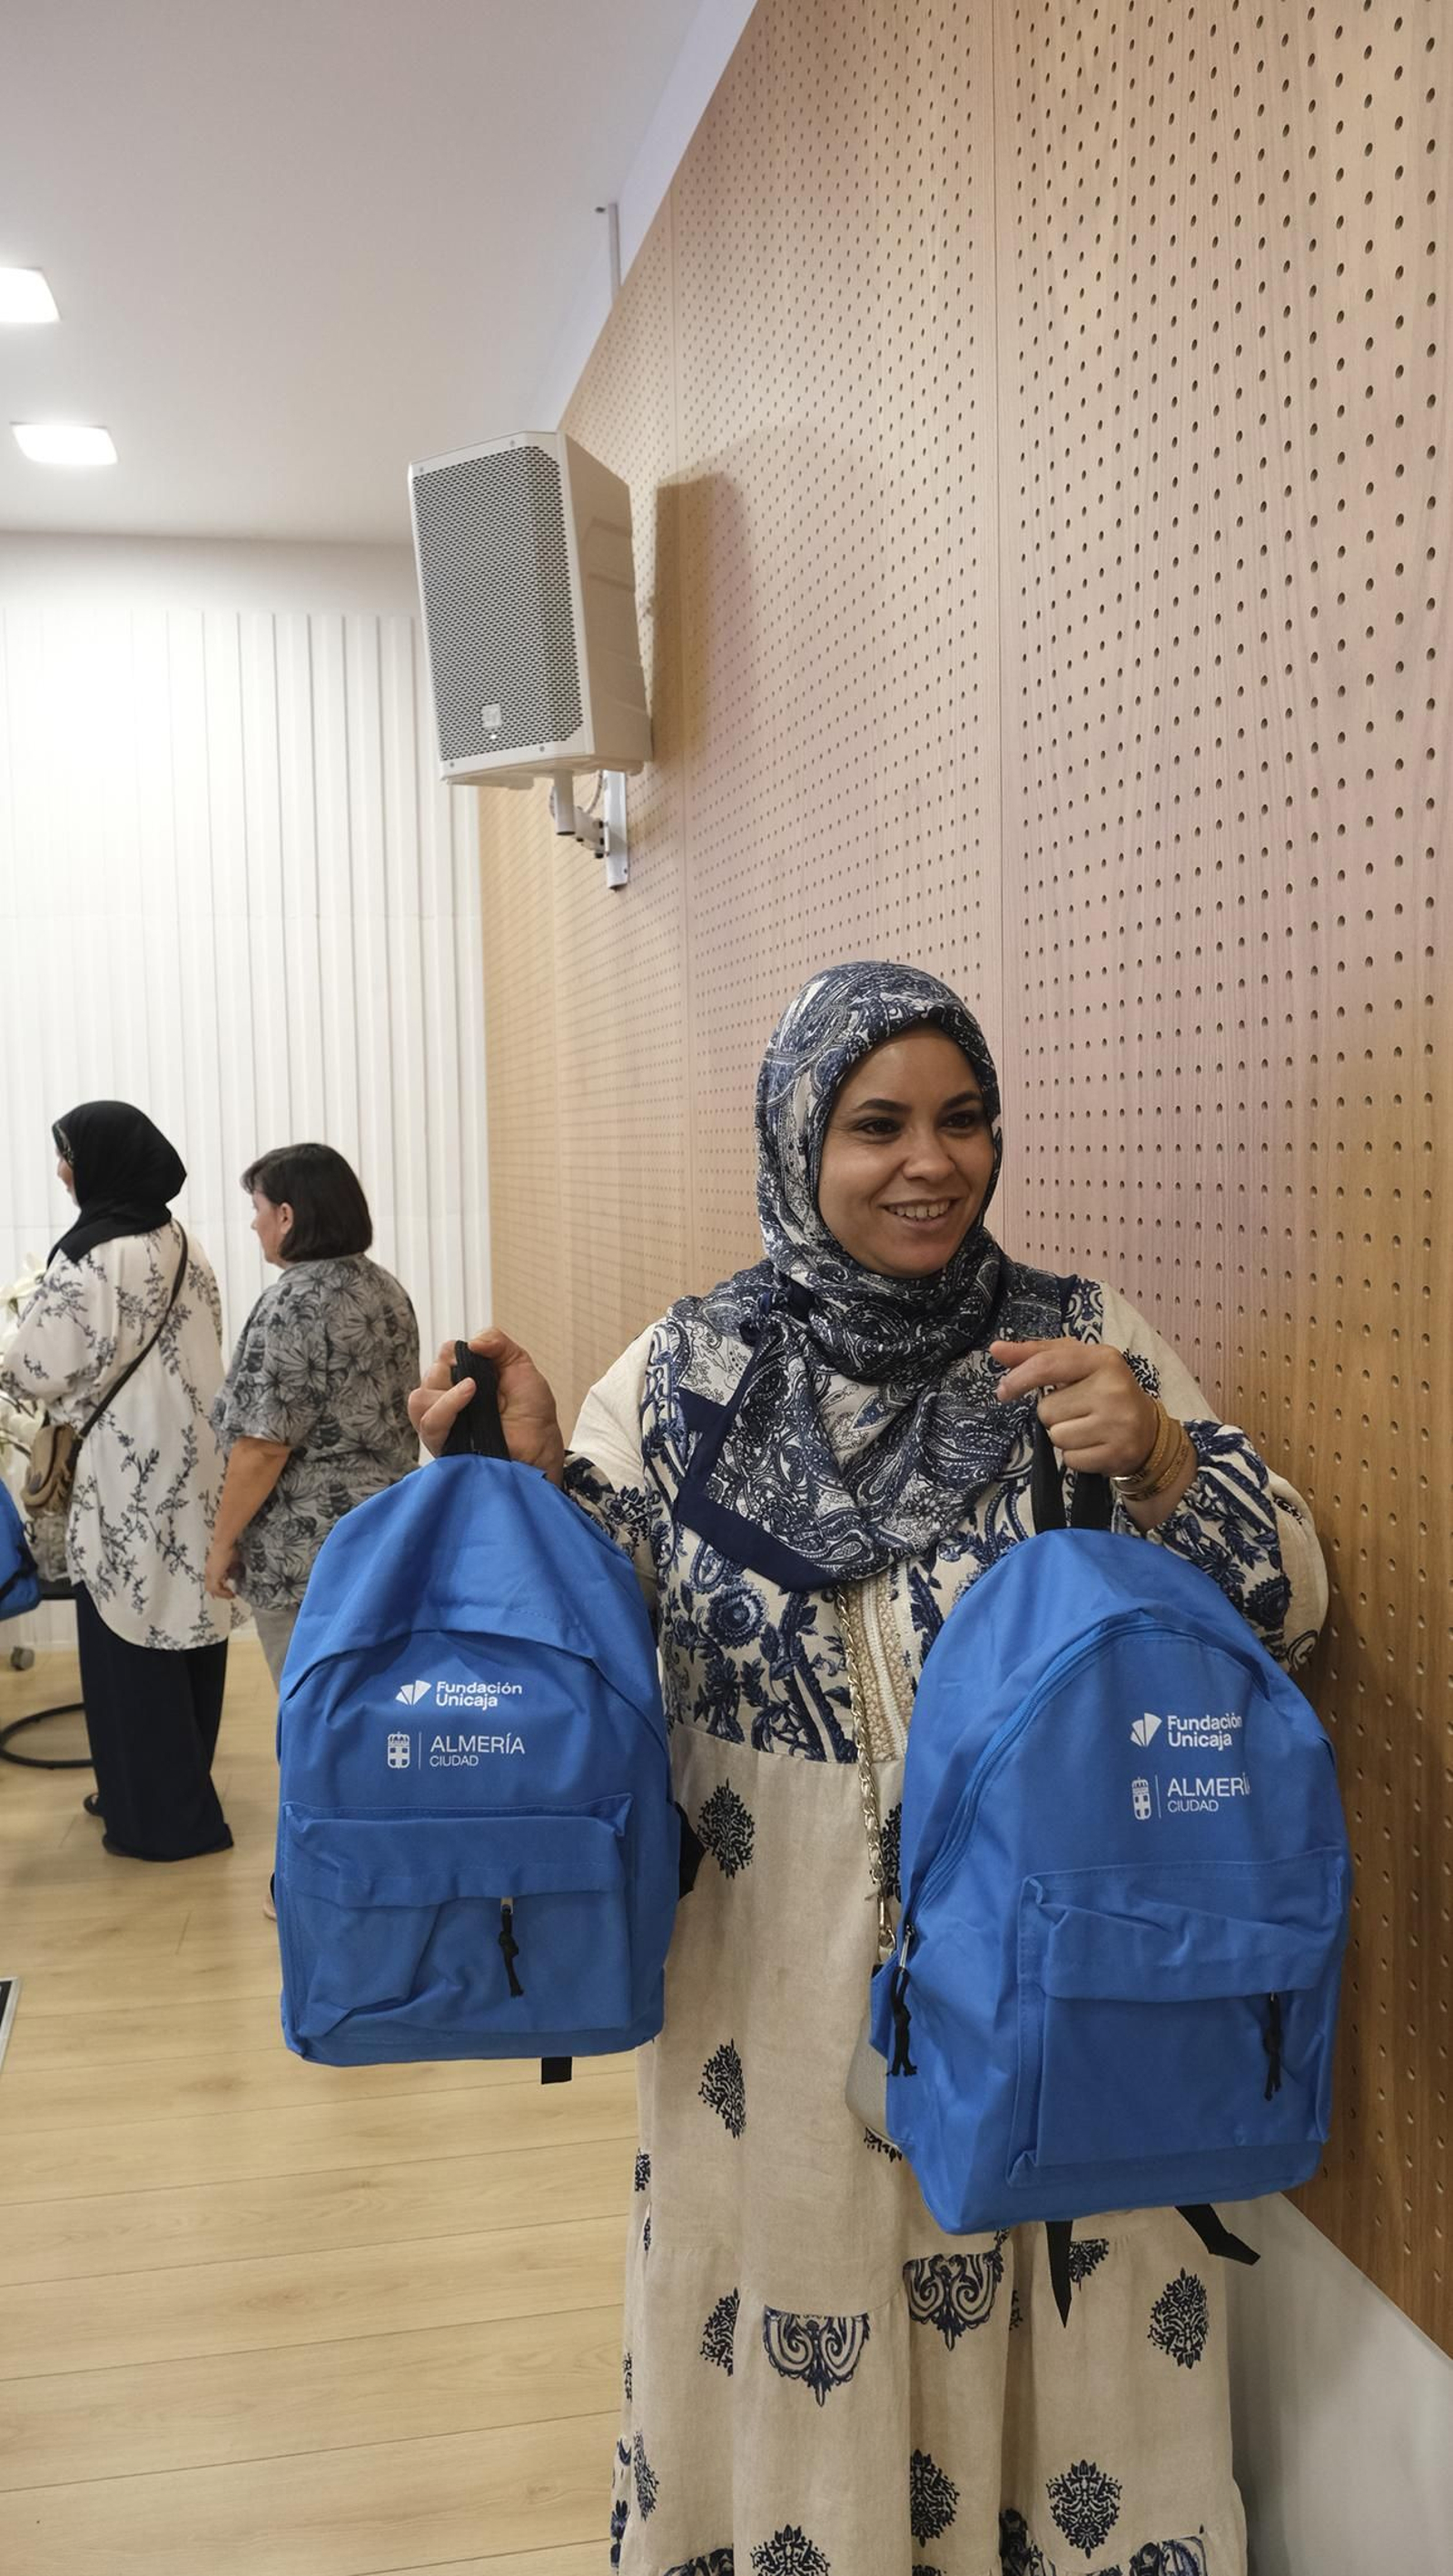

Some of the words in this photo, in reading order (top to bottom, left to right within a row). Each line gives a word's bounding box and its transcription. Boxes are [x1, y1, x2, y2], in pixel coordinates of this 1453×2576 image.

[436, 1681, 523, 1695] Fundación
[436, 1693, 499, 1711] Unicaja
[430, 1732, 526, 1754] ALMERÍA
[1168, 1731, 1233, 1751] Unicaja
[430, 1755, 479, 1767] CIUDAD
[1167, 1799, 1220, 1812] CIUDAD
